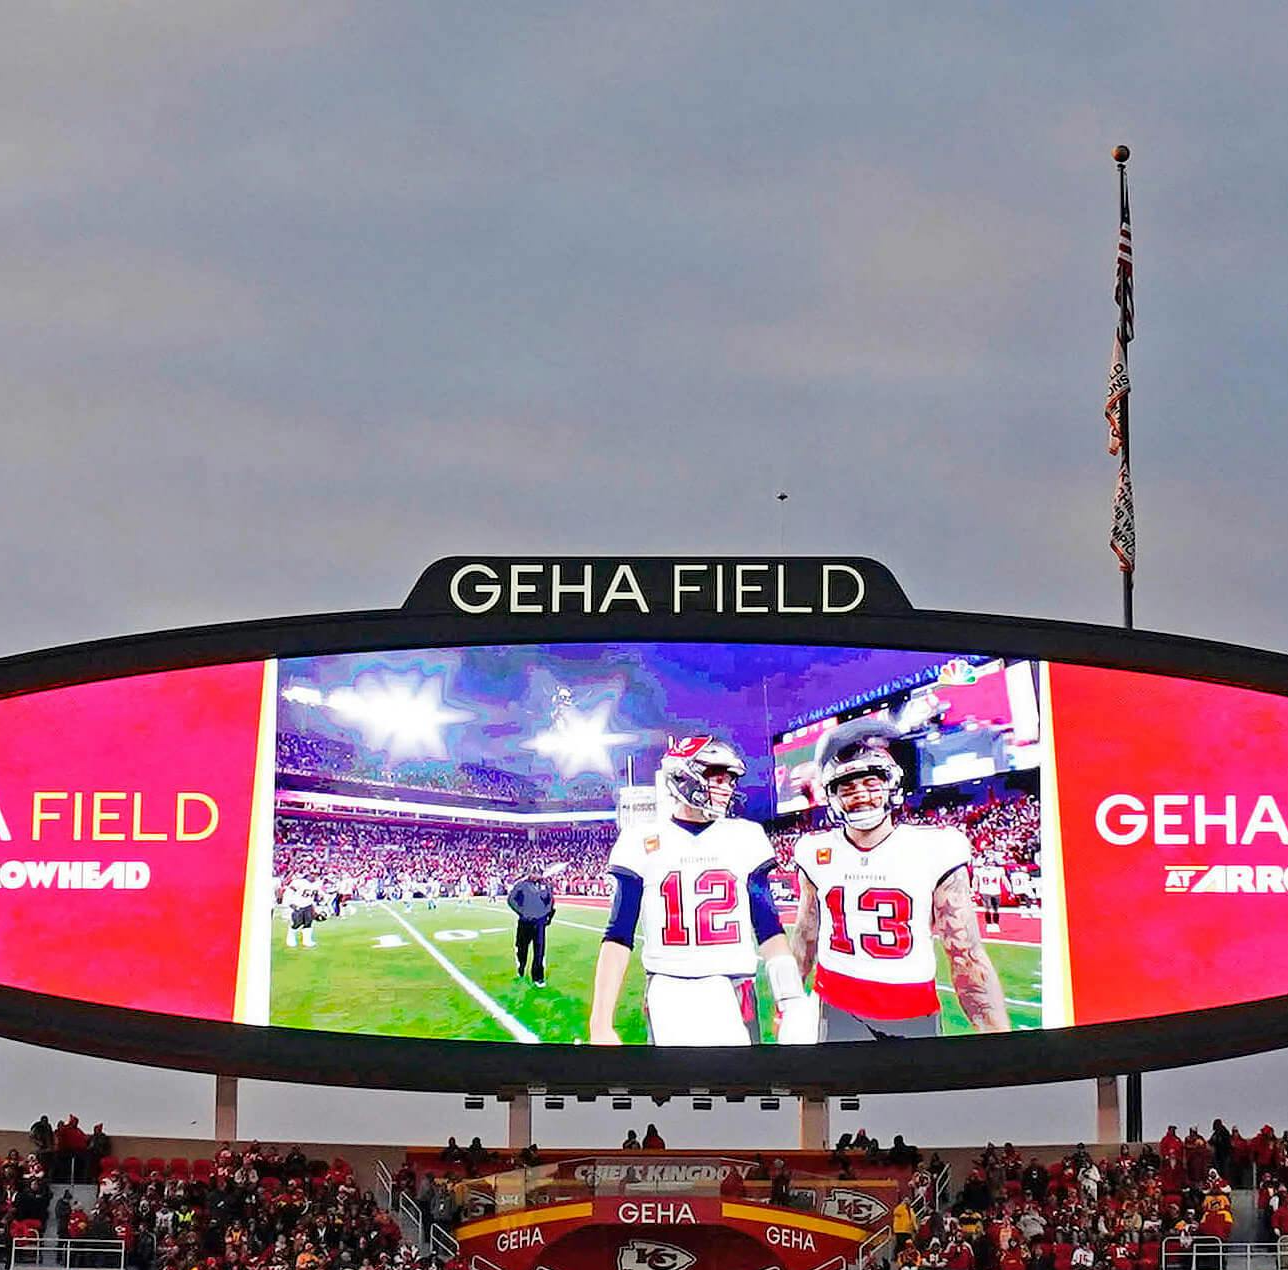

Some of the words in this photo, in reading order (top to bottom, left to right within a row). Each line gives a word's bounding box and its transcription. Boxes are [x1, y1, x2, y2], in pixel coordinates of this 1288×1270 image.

[450, 564, 650, 614] GEHA
[673, 564, 865, 614] FIELD
[32, 791, 220, 842] FIELD
[1166, 872, 1194, 892] AT
[660, 869, 741, 946] 12
[825, 887, 913, 960] 13
[618, 1203, 696, 1224] GEHA
[497, 1225, 544, 1251] GEHA
[766, 1226, 816, 1253] GEHA
